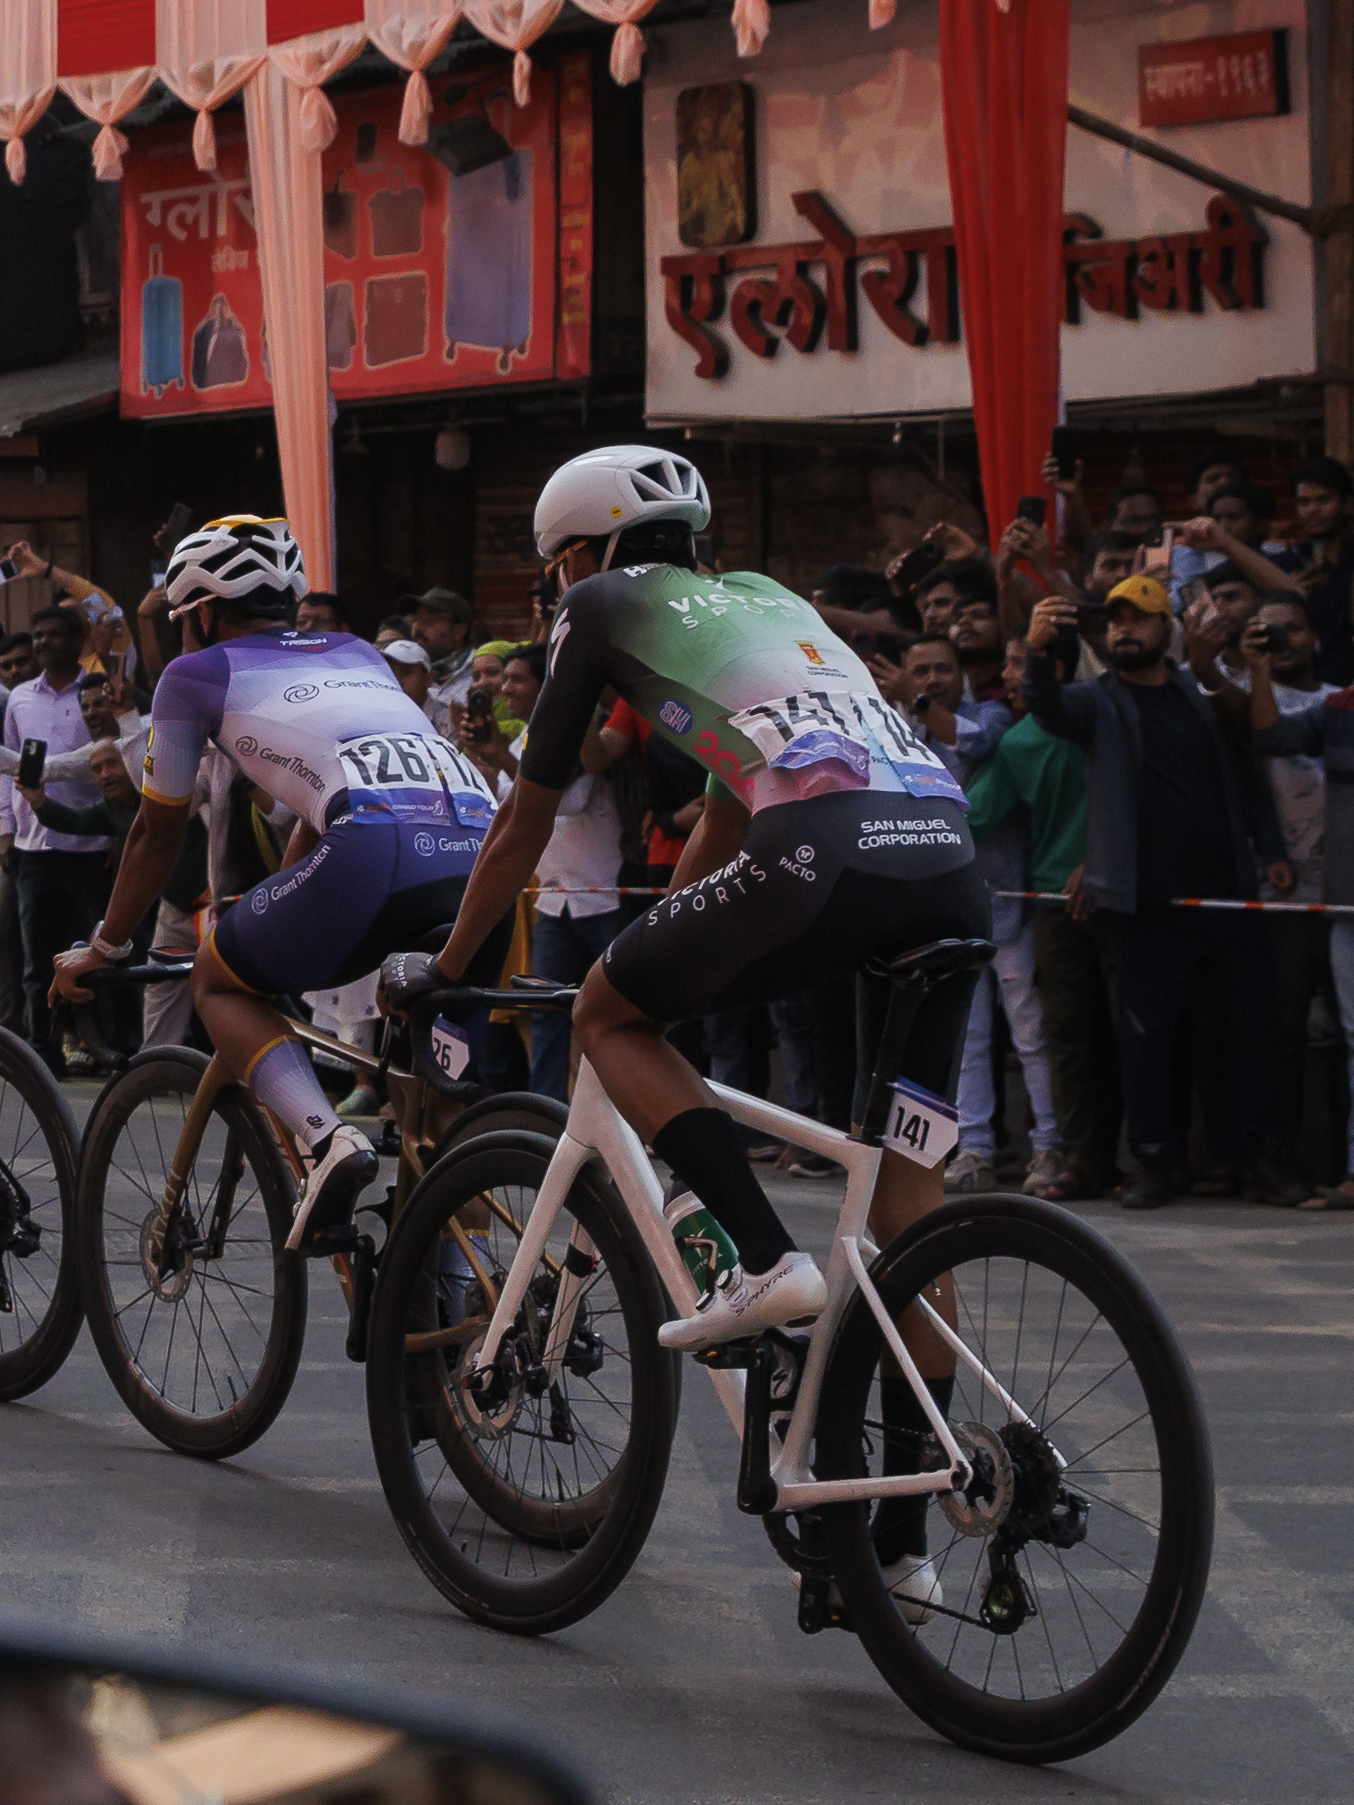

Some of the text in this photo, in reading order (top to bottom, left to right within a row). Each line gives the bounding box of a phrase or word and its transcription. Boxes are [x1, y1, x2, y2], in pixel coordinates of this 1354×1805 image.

[339, 737, 431, 787] 126
[860, 818, 952, 834] SAN MIGUEL
[438, 838, 470, 853] Grant
[857, 831, 963, 851] CORPORATION
[778, 856, 817, 883] PACTO
[647, 863, 768, 927] SPORTS
[892, 1104, 931, 1153] 141
